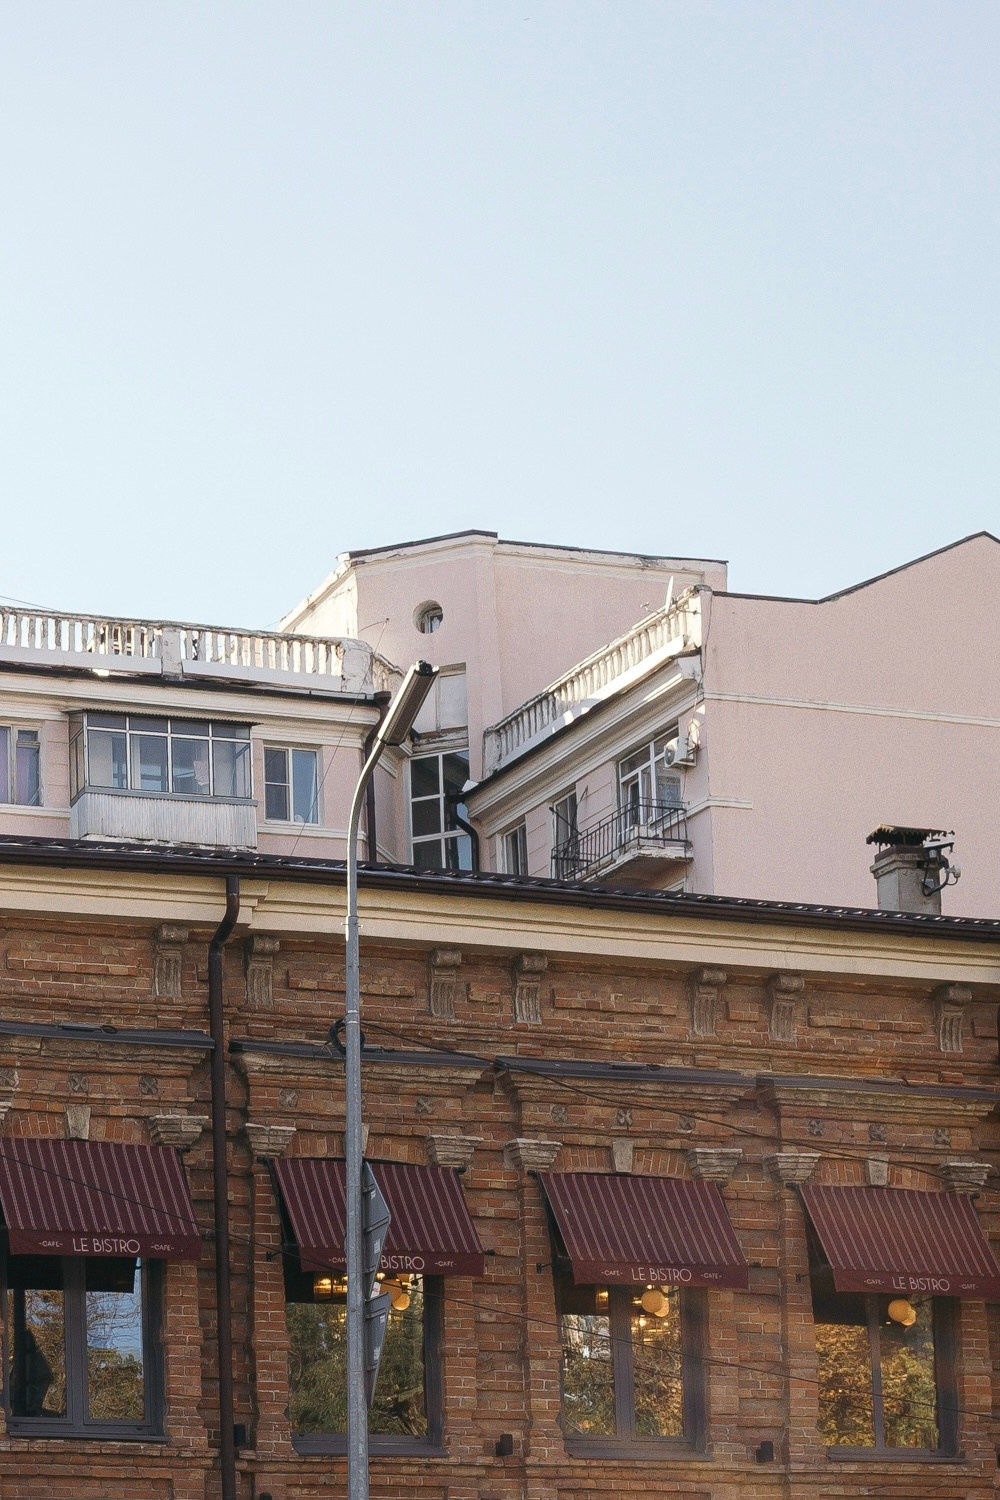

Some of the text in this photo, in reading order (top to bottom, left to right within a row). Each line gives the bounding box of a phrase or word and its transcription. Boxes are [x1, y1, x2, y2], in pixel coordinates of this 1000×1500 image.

[72, 1238, 88, 1252] LE
[92, 1238, 140, 1253] BISTRO
[380, 1255, 425, 1270] BISTRO
[631, 1267, 646, 1281] LE
[649, 1267, 692, 1282] BISTRO
[891, 1276, 907, 1290] LE
[908, 1277, 950, 1291] BISTRO
